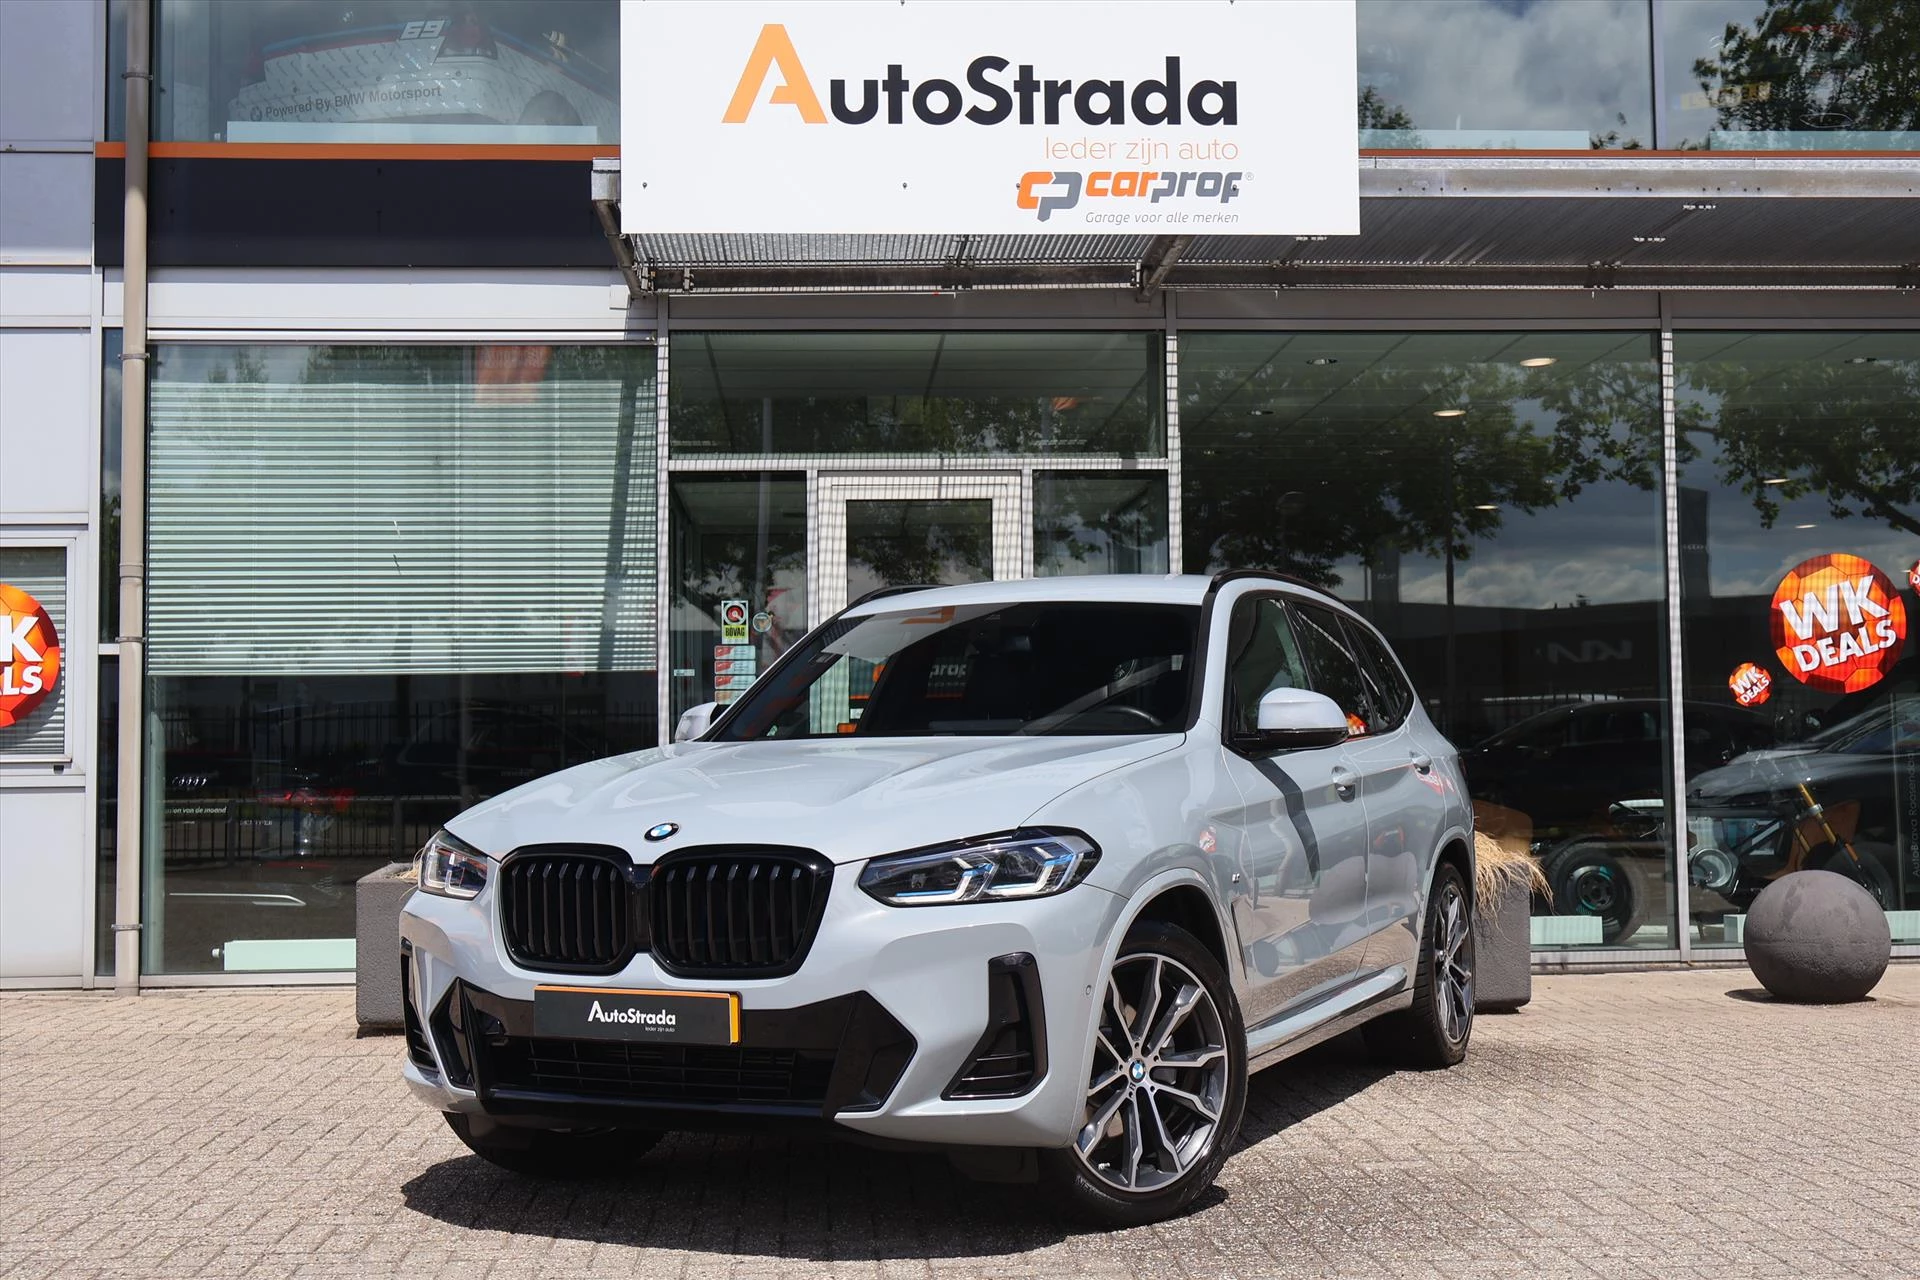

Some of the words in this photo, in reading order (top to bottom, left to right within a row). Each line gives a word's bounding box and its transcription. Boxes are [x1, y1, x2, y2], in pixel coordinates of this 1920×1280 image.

[401, 20, 444, 40] 69
[721, 23, 1238, 126] AutoStrada
[265, 99, 312, 118] Powered
[315, 97, 331, 111] By
[334, 90, 366, 108] BMW
[368, 84, 442, 103] Motorsport
[1045, 136, 1117, 160] Ieder
[1125, 137, 1169, 166] zijn
[1178, 139, 1239, 160] auto
[1085, 171, 1242, 203] carprof
[1085, 211, 1130, 226] Garage
[1134, 214, 1163, 223] voor
[1166, 211, 1189, 223] alle
[1193, 211, 1239, 223] merken
[1779, 575, 1890, 640] WK
[0, 615, 44, 662] K
[725, 627, 745, 637] BOVAG
[1792, 619, 1897, 673] DEALS
[1730, 666, 1764, 695] WK
[1740, 677, 1770, 703] DEALS
[588, 1000, 676, 1026] AutoStrada
